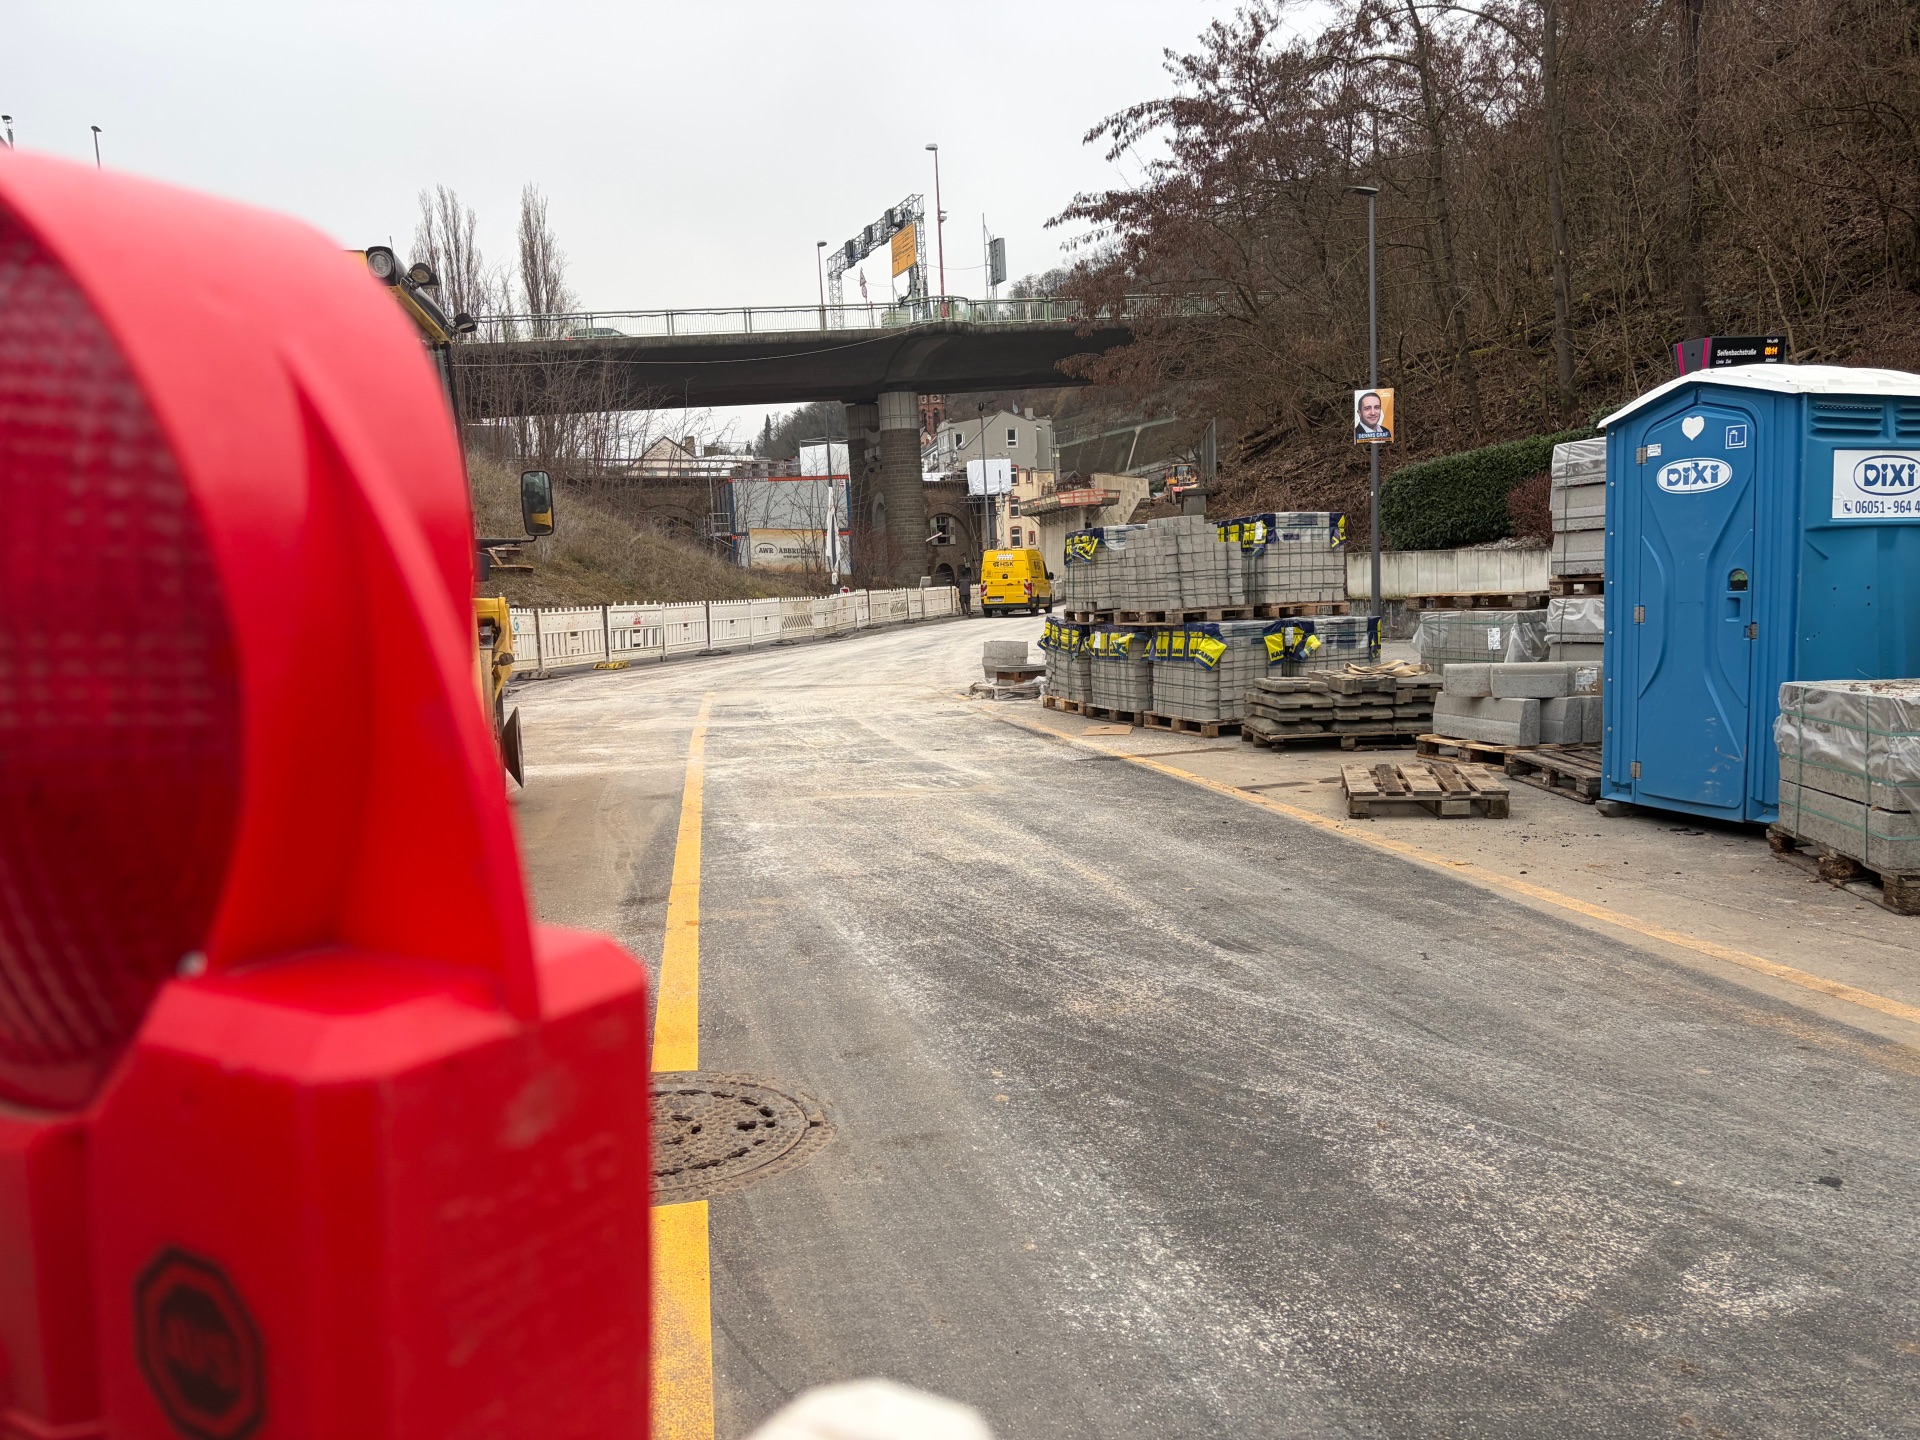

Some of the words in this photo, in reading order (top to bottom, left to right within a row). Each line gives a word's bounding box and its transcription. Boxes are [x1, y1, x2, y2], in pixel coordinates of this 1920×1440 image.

[1716, 349, 1757, 357] Seifenbachstraße
[1855, 500, 1885, 514] 06051
[1893, 500, 1912, 514] 964
